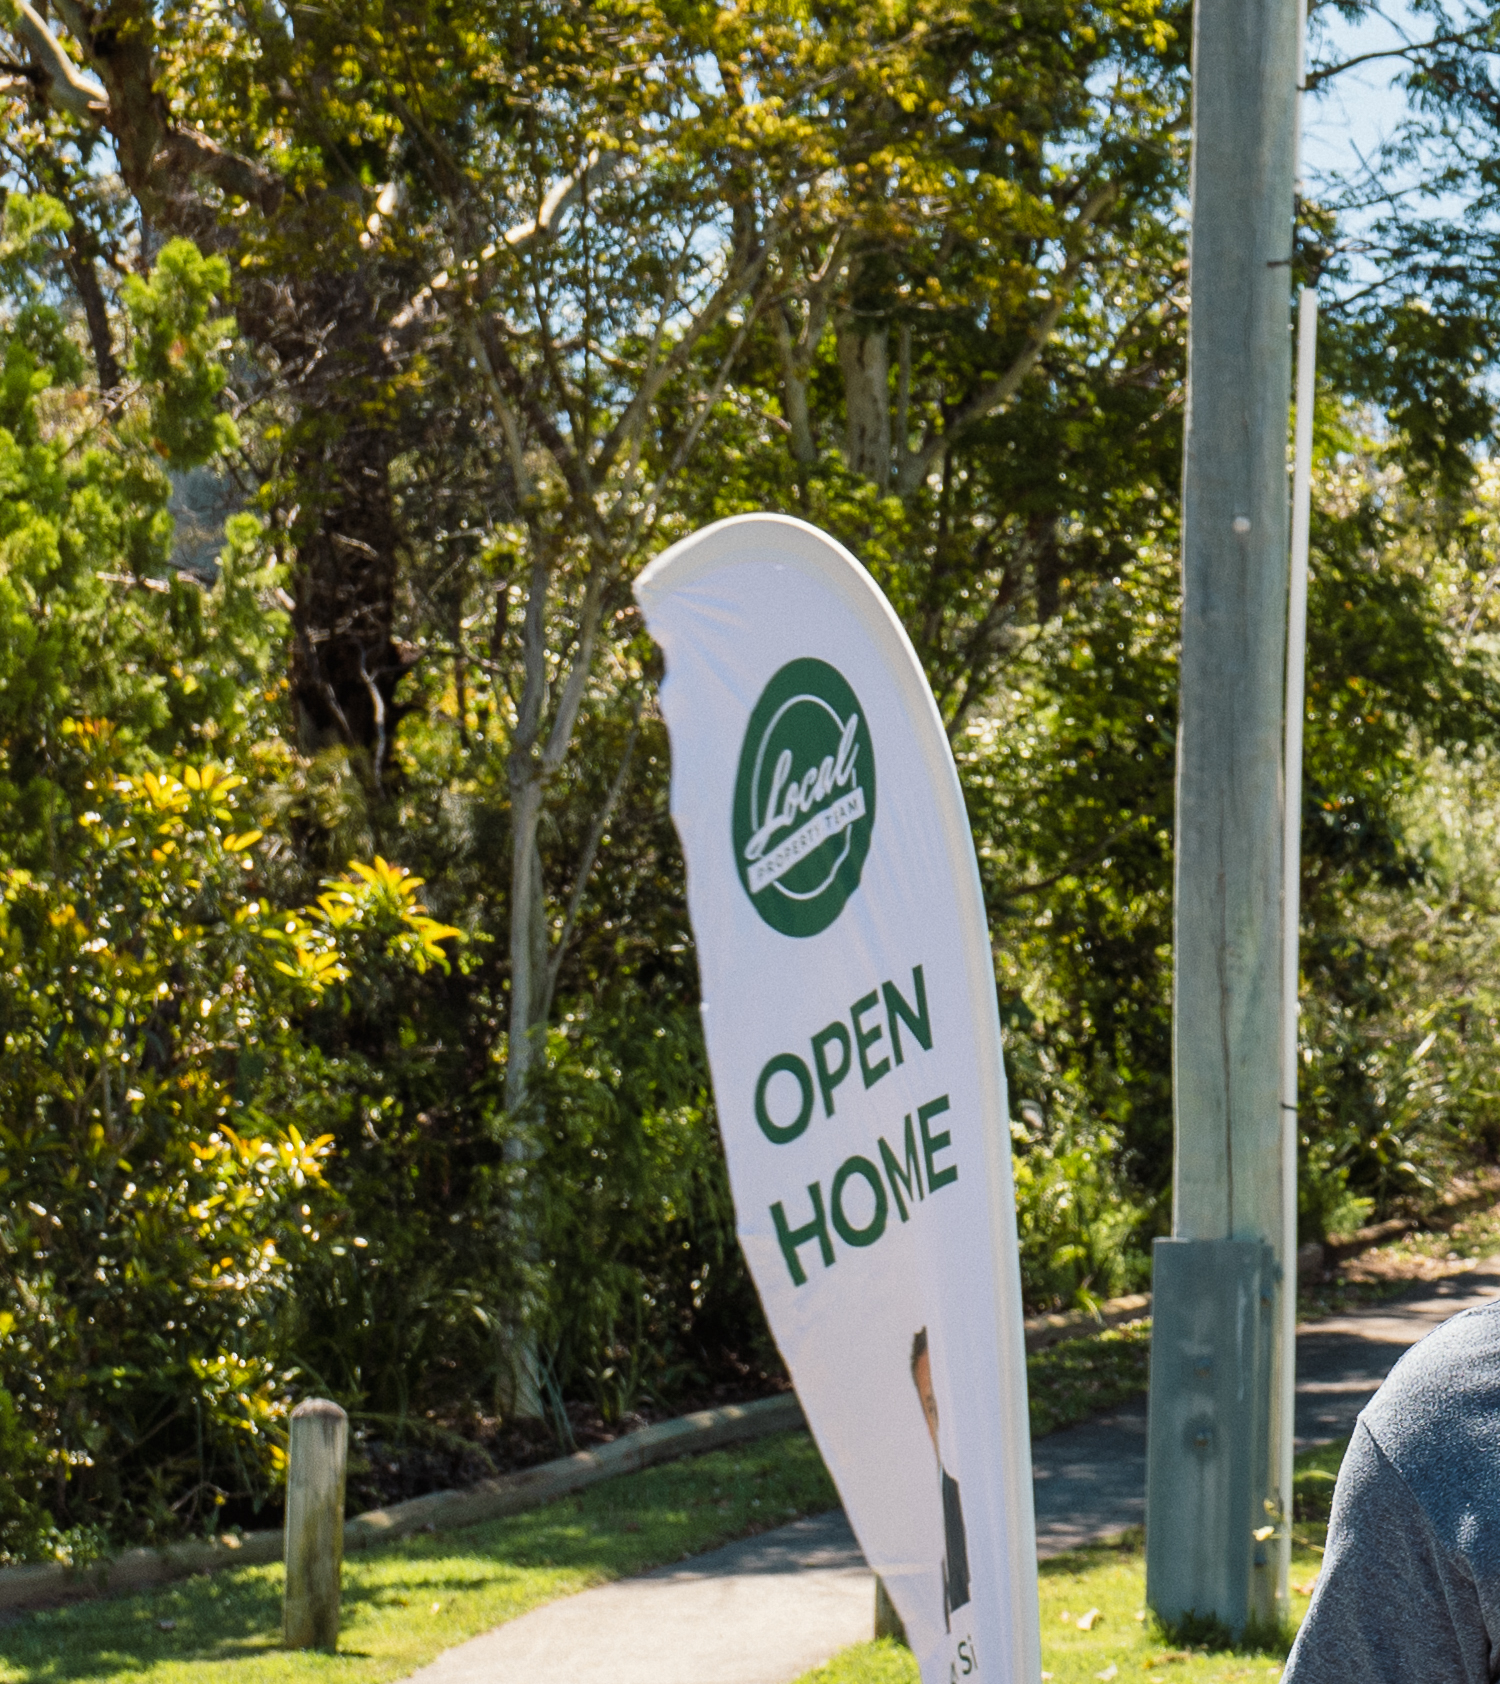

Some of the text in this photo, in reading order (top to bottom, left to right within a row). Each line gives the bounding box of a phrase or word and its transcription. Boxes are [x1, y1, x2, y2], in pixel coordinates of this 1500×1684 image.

[744, 712, 860, 860] Local
[755, 965, 933, 1145] OPEN
[770, 1095, 959, 1287] HOME
